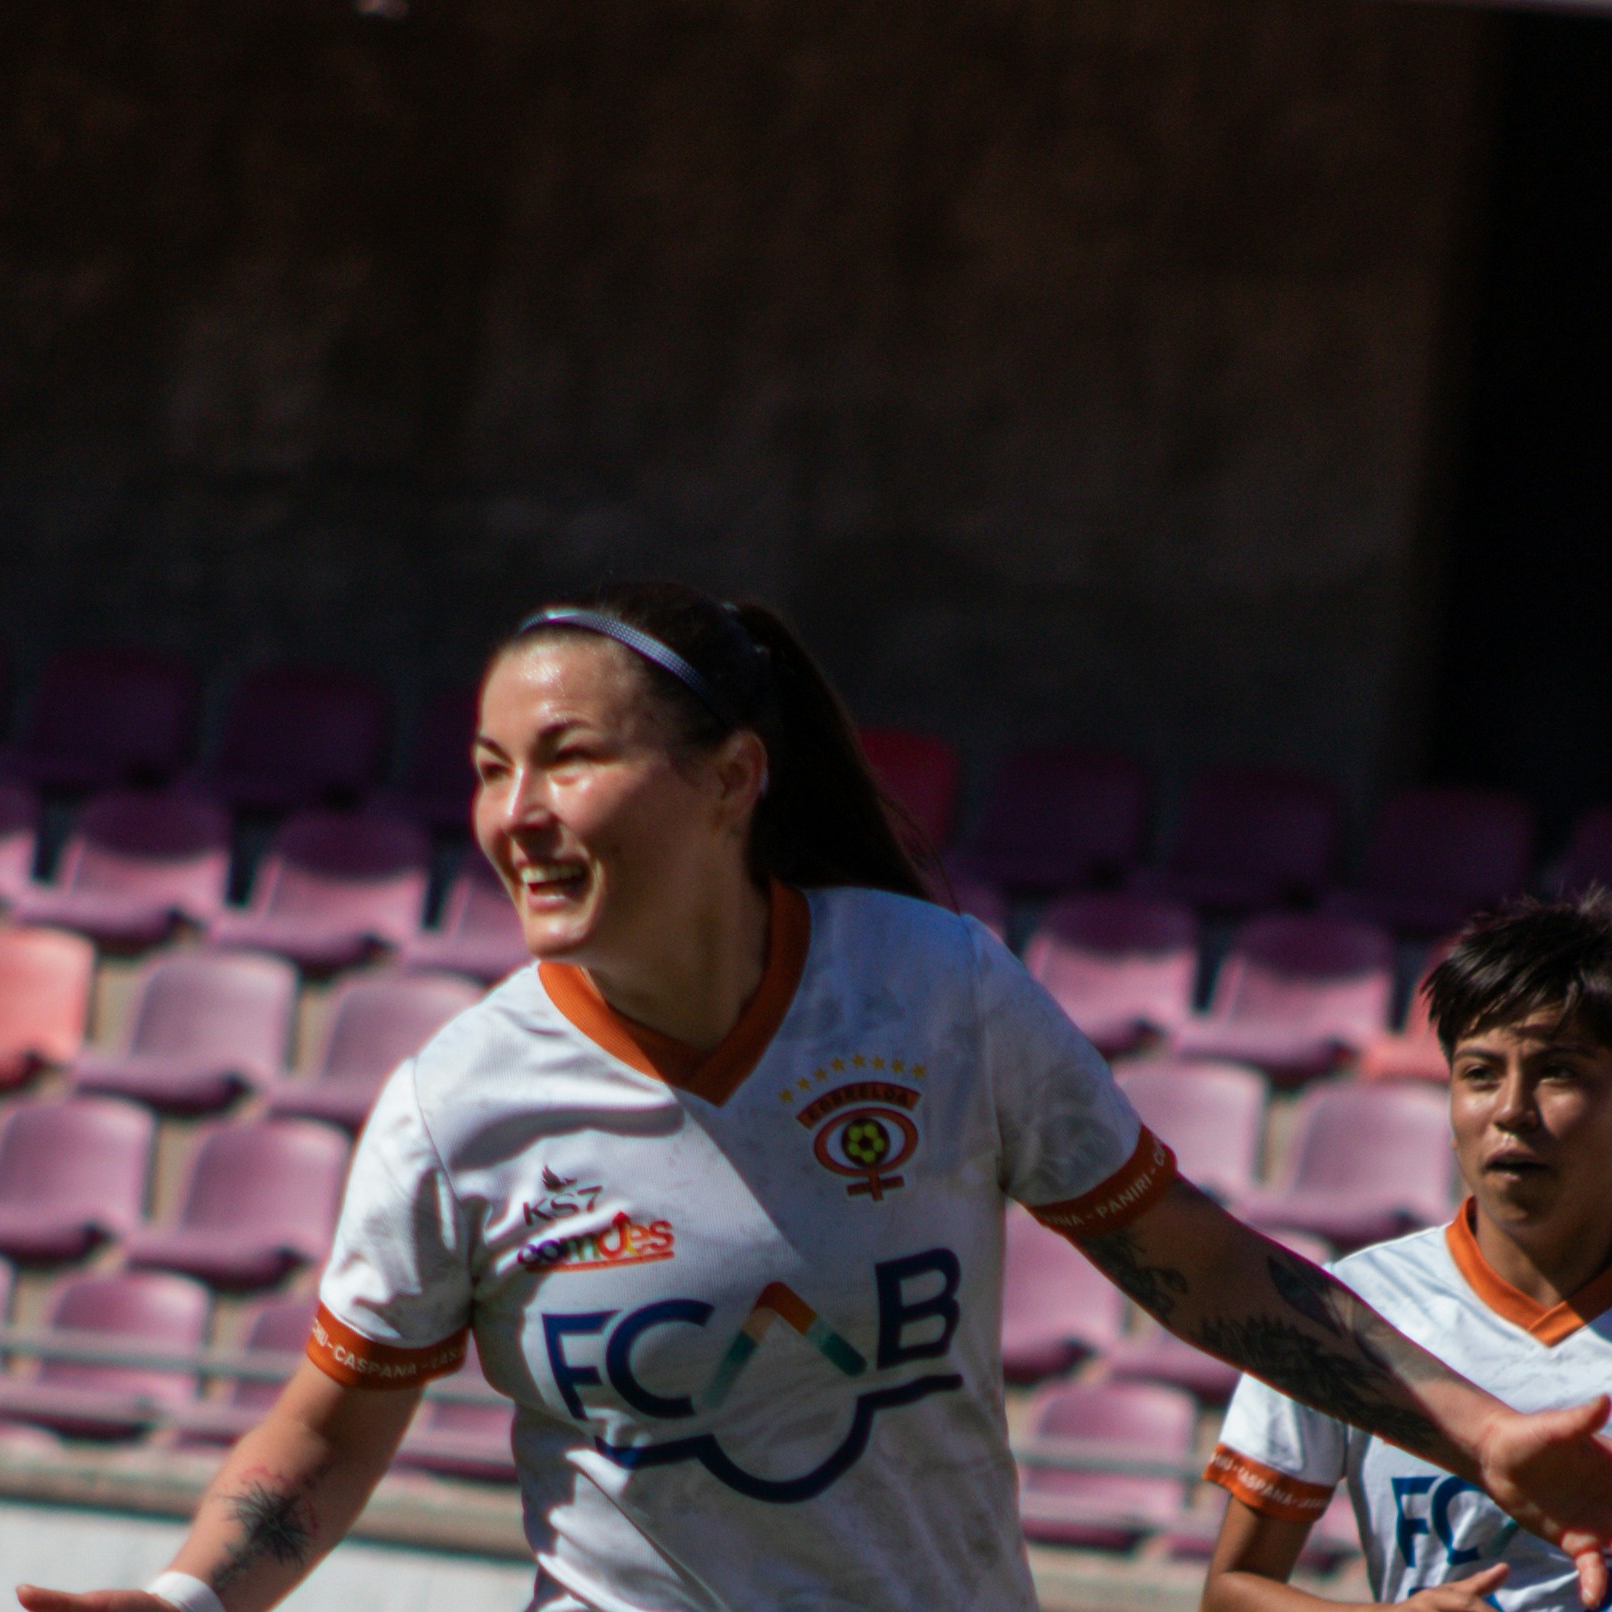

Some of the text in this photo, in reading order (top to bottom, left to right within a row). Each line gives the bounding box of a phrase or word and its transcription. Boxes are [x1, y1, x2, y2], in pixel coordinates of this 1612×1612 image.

[523, 1185, 603, 1226] KS7
[541, 1248, 962, 1420] FCAB
[333, 1343, 417, 1379] CASPANA
